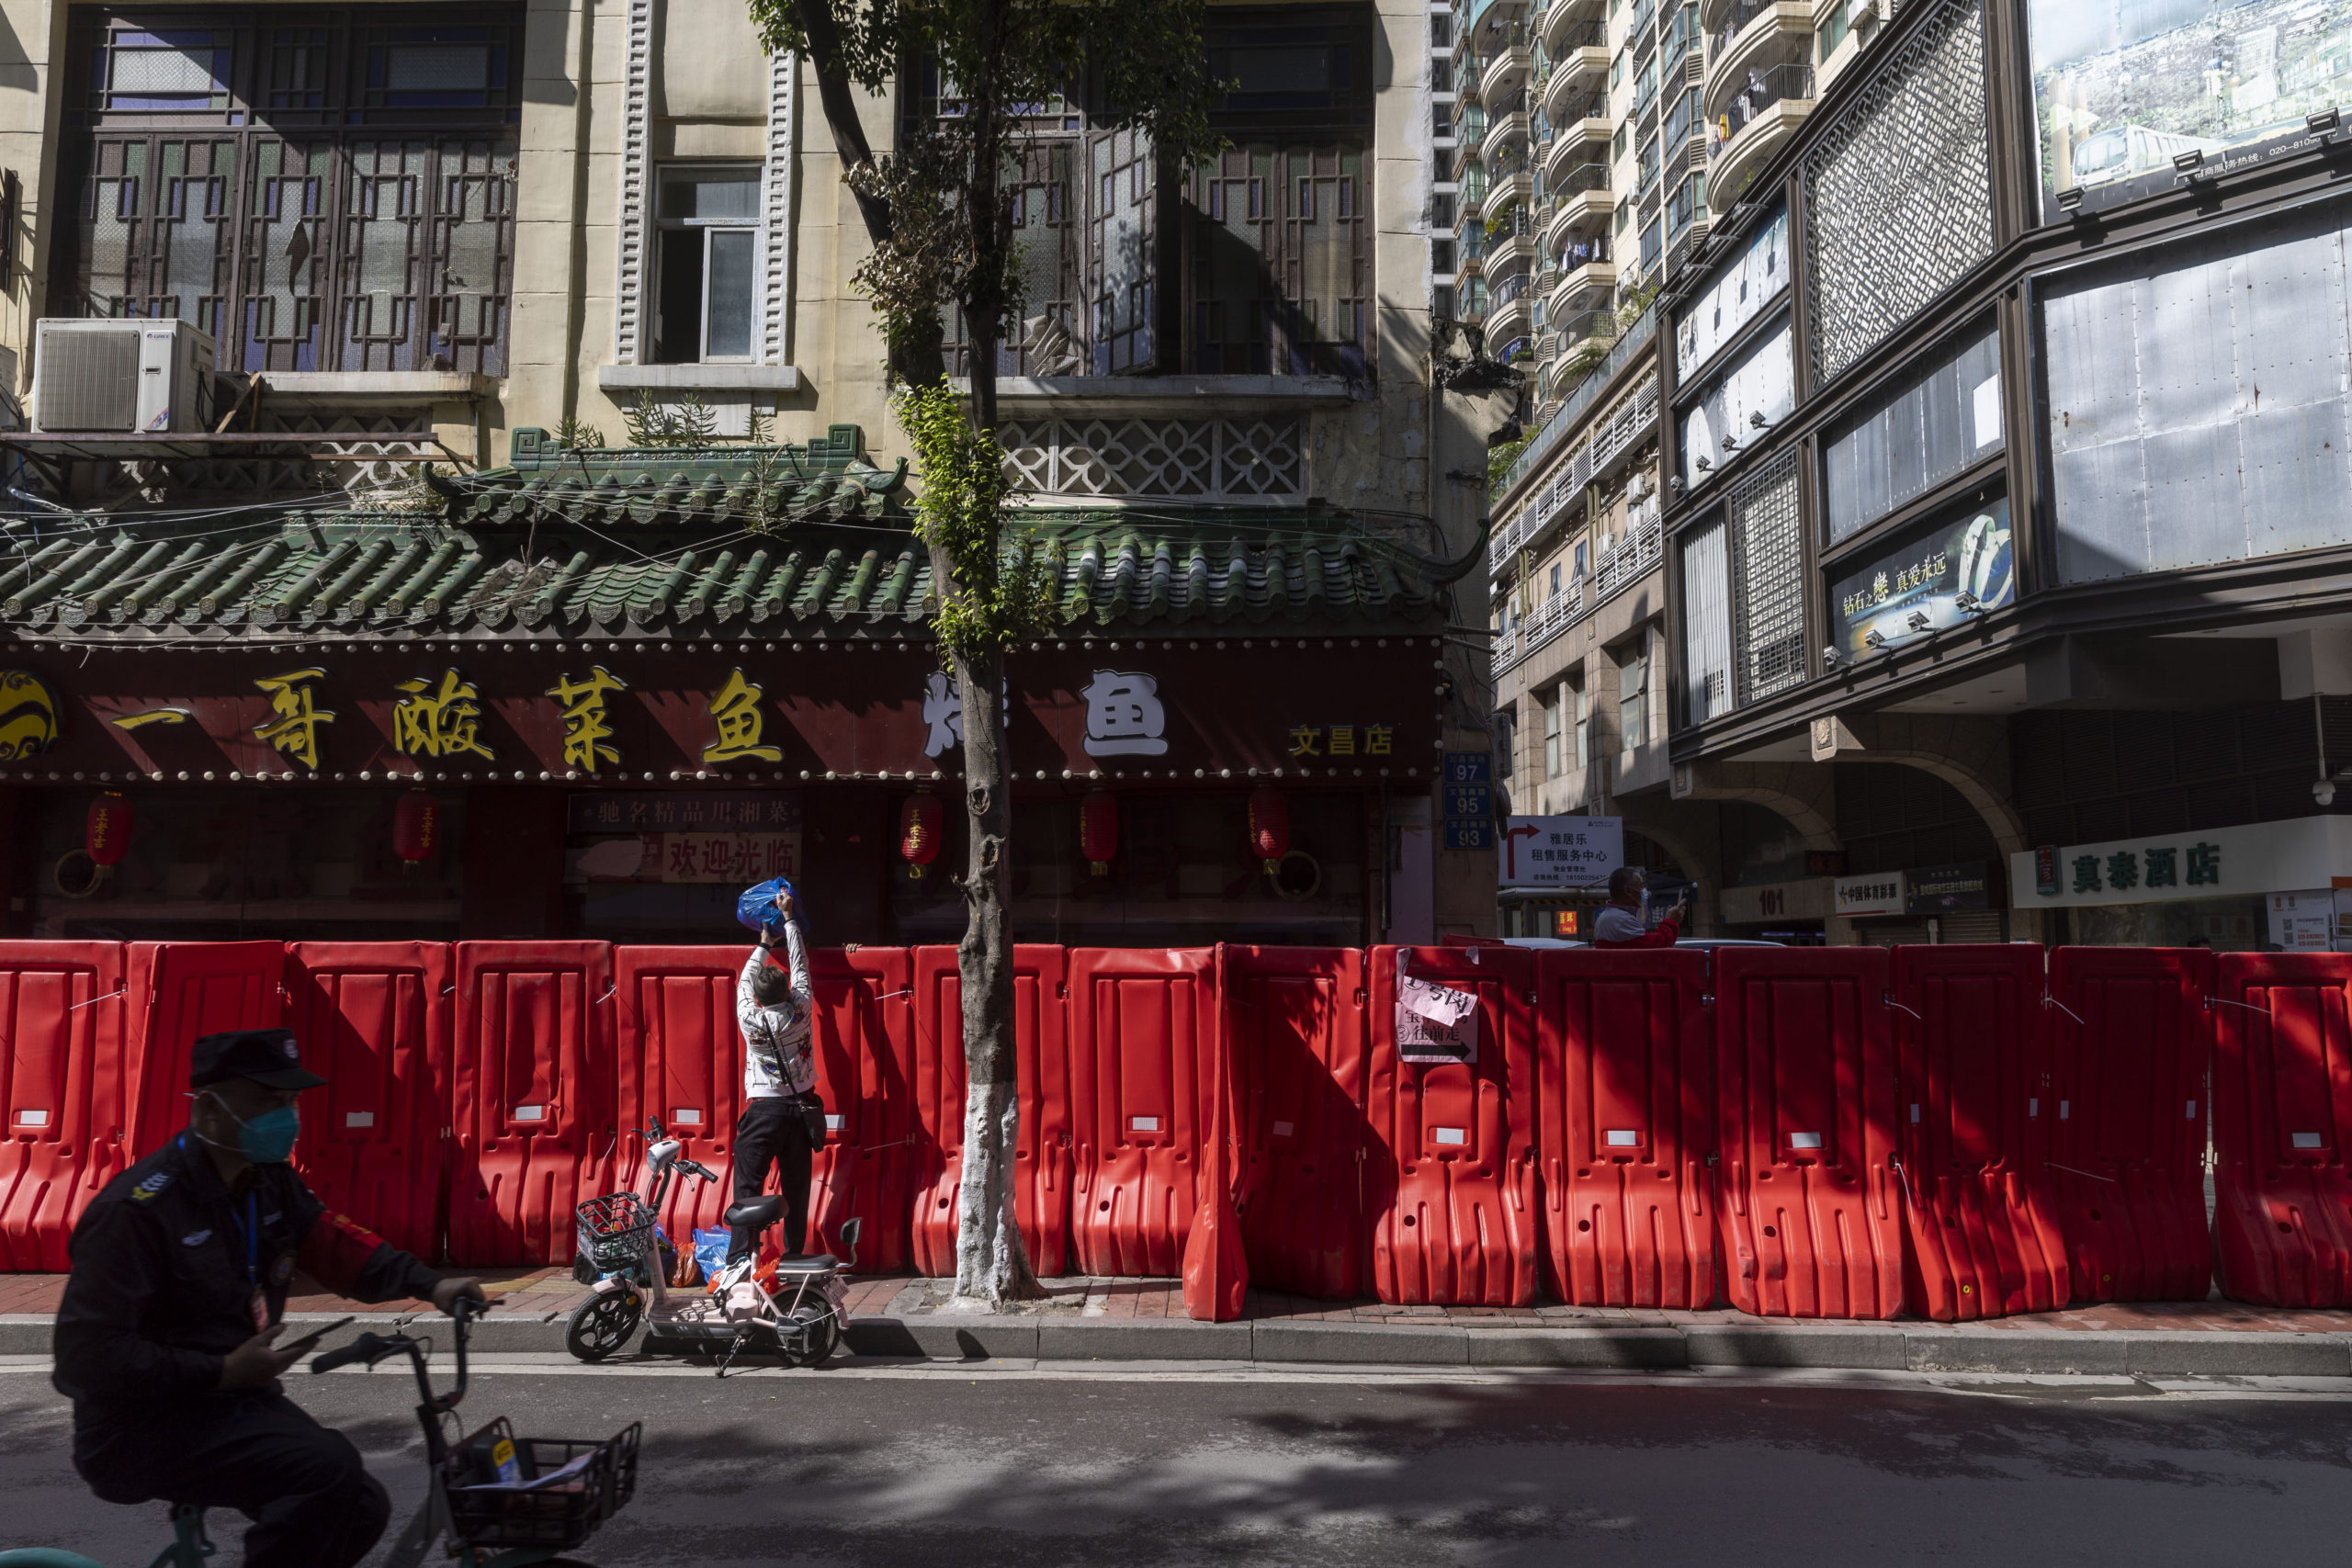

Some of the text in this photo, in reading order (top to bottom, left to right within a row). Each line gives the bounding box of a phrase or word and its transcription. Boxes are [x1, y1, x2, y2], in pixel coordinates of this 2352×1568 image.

[1895, 551, 1947, 595] 真爱永远
[109, 665, 784, 773] 一哥酸菜鱼
[1288, 724, 1394, 756] 文昌店
[1456, 764, 1478, 781] 97
[598, 801, 789, 824] 驰名精品川湘菜
[1457, 797, 1478, 814] 95
[94, 808, 109, 849] 王老吉
[420, 807, 435, 848] 王老吉
[1458, 829, 1480, 846] 93
[1550, 832, 1588, 846] 雅居乐
[669, 839, 795, 875] 欢迎光临
[1532, 849, 1608, 862] 租售服务中心
[2072, 841, 2221, 894] 莫泰酒店
[1759, 888, 1785, 916] 101
[1848, 883, 1897, 902] 中国体育彩票
